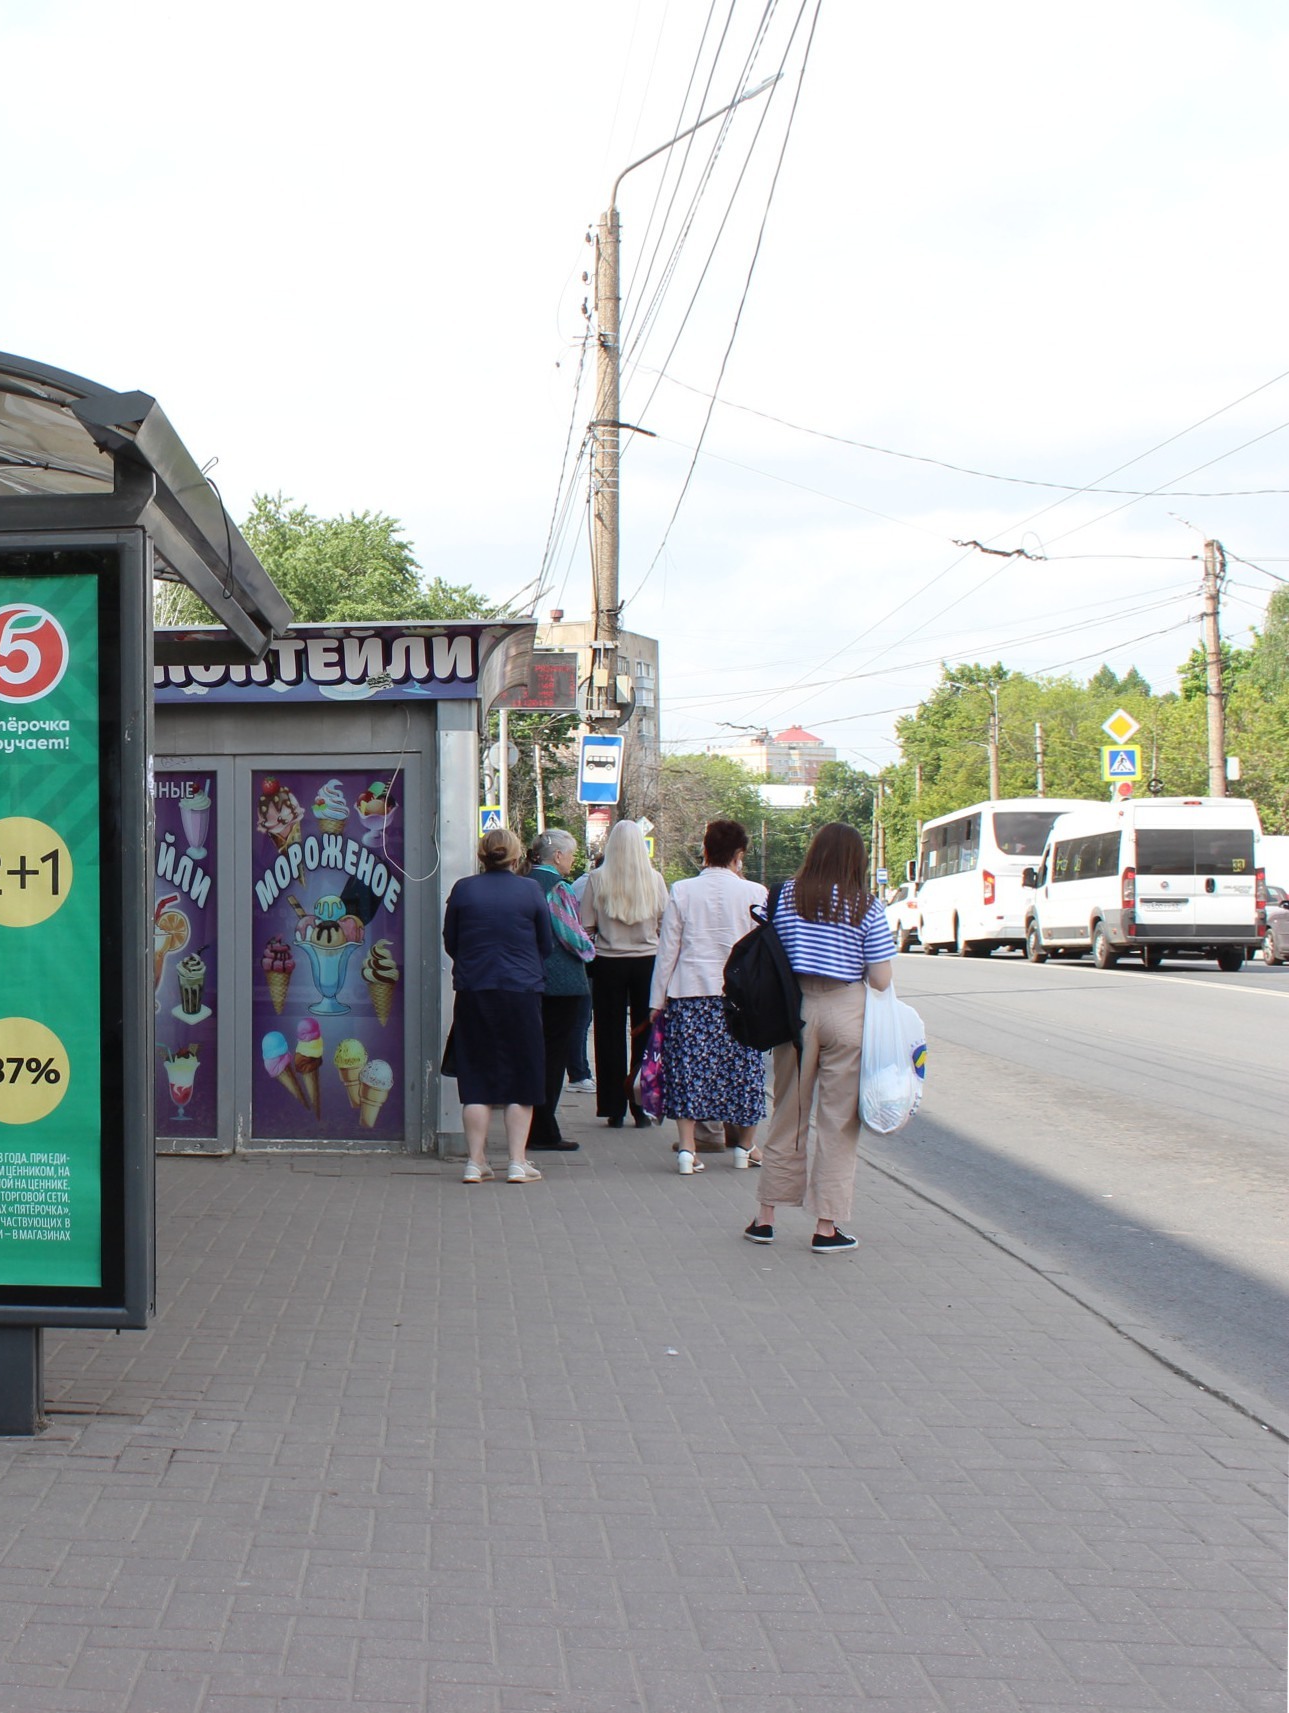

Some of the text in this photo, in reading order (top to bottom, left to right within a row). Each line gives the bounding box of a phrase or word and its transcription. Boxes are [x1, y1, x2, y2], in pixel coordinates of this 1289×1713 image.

[157, 832, 212, 909] ЙЛИ
[255, 833, 402, 913] МОРОЖЕНОЕ
[4, 1153, 29, 1166] ГОДА.
[29, 1153, 48, 1164] ПРИ
[48, 1154, 70, 1167] ЕДИ-
[5, 1166, 57, 1179] ЦЕННИКОМ,
[58, 1167, 70, 1178] НА
[14, 1179, 27, 1190] НА
[28, 1179, 70, 1192] ЦЕННИКЕ.
[0, 1189, 45, 1203] ТОРГОВОЙ
[46, 1192, 71, 1203] СЕТИ.
[8, 1201, 71, 1215] «ПЯТЁРОЧКА».
[65, 1217, 70, 1228] В
[13, 1228, 18, 1239] В
[19, 1228, 71, 1240] МАГАЗИНАХ
